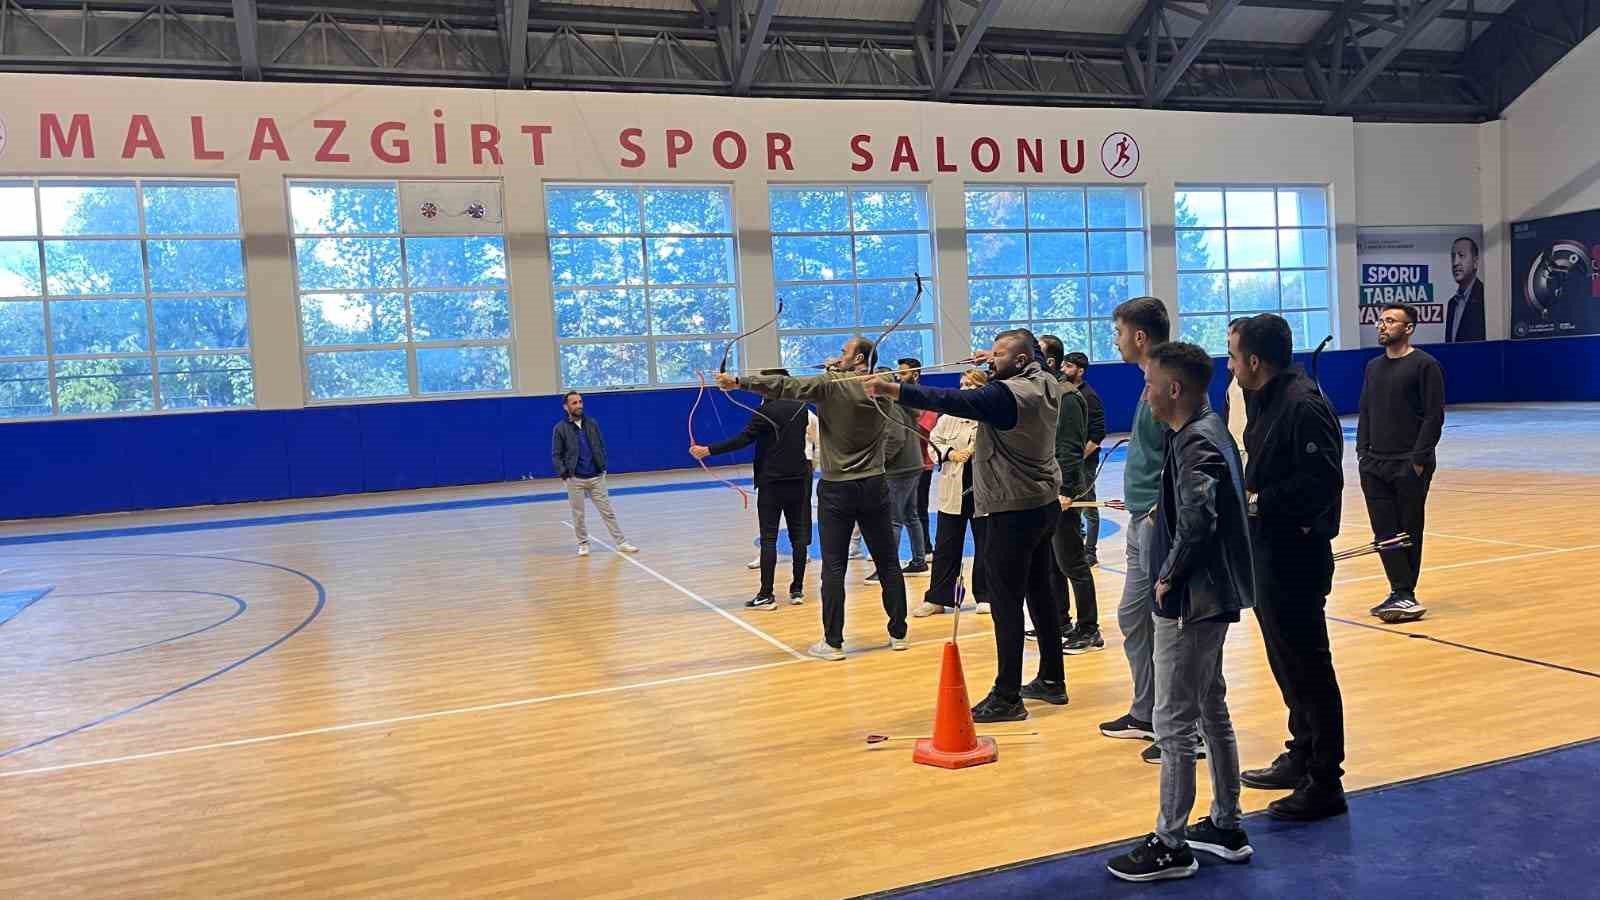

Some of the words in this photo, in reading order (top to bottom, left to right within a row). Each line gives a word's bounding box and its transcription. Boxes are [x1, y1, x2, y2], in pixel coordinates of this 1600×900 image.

[39, 110, 553, 167] MALAZGİRT
[619, 128, 795, 172] SPOR
[850, 134, 1085, 174] SALONU
[1367, 266, 1420, 283] SPORU
[1363, 285, 1429, 304] TABANA
